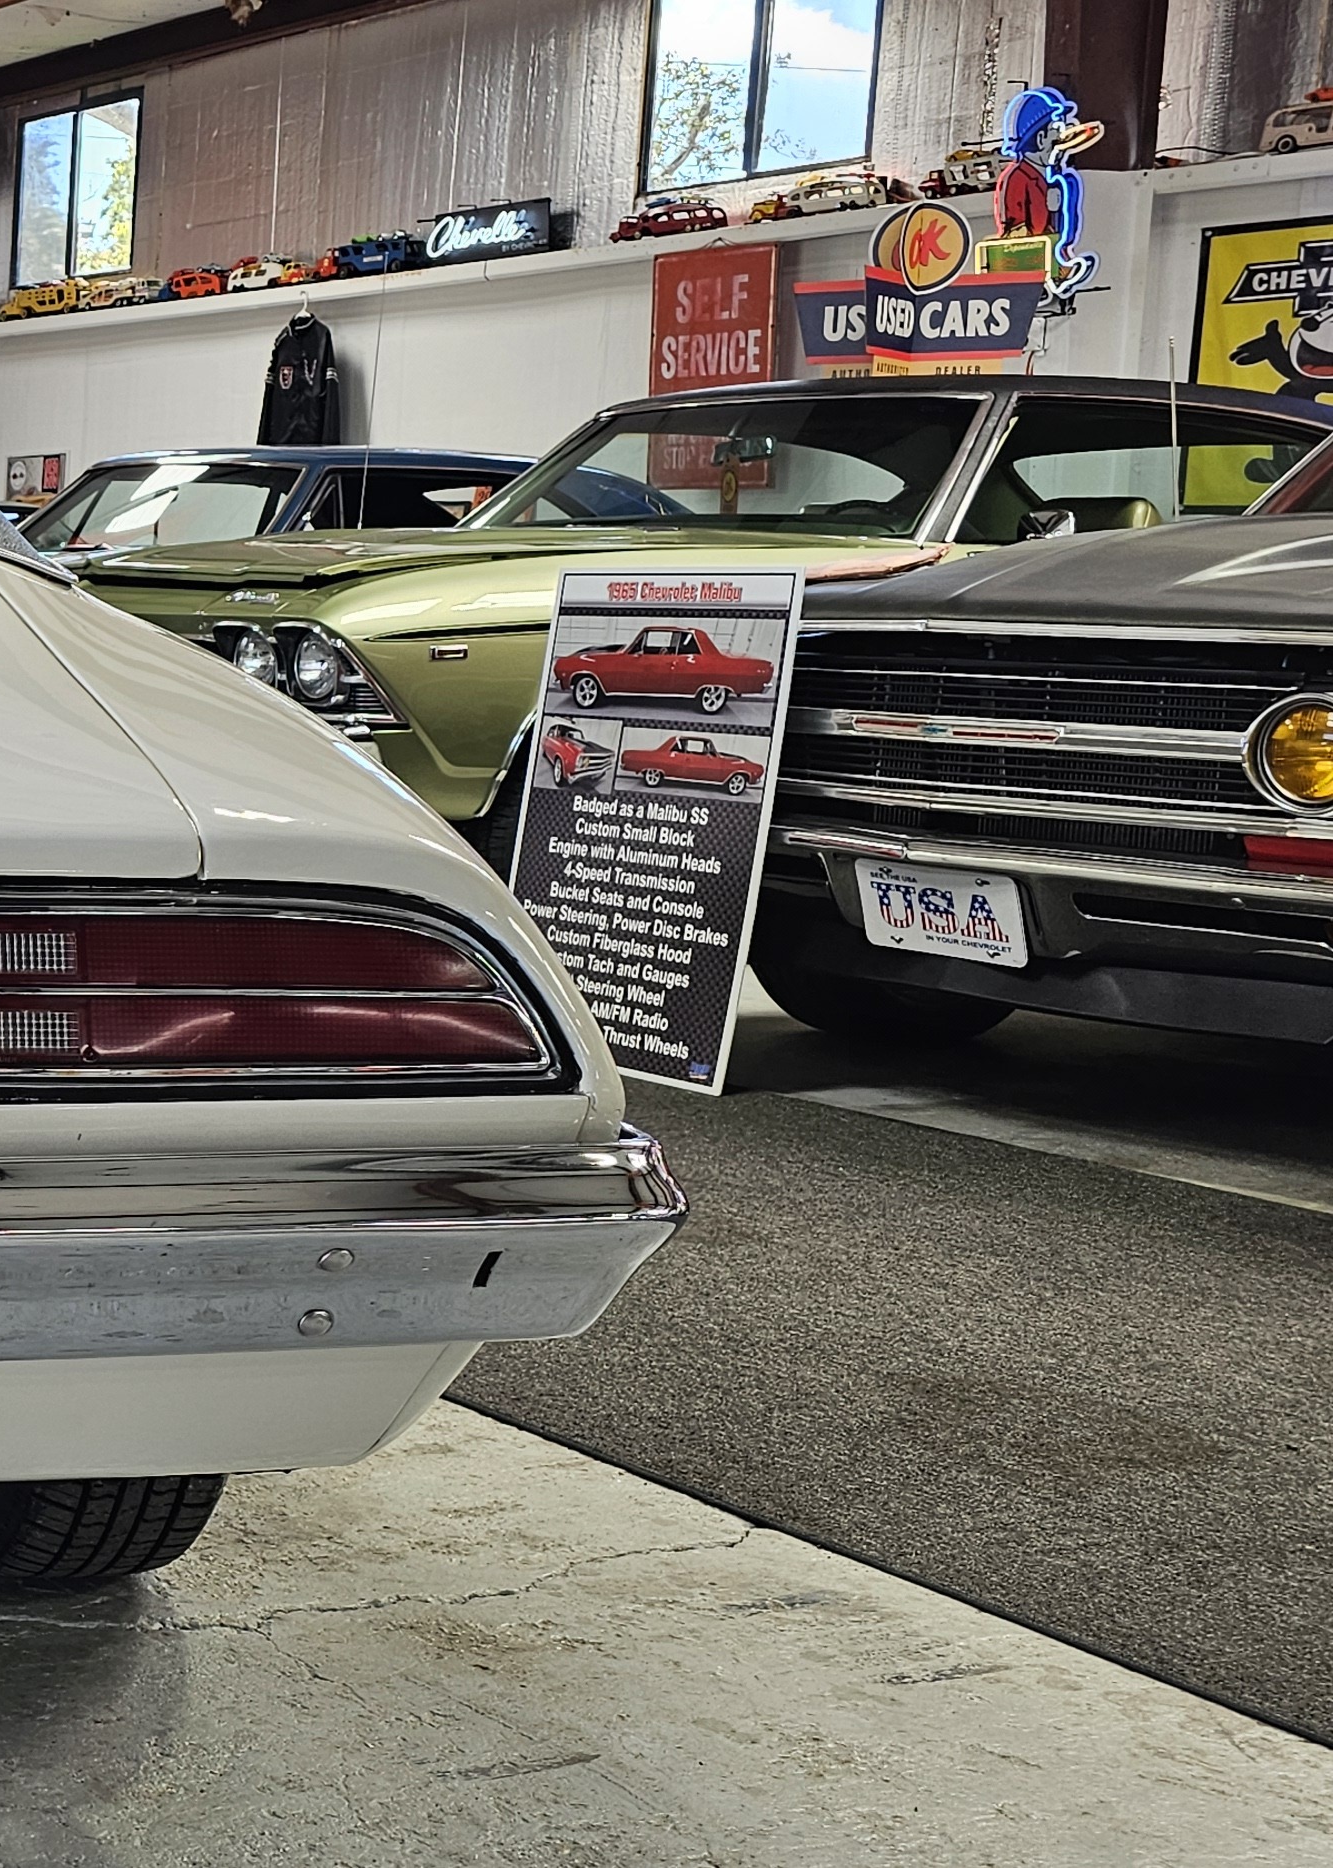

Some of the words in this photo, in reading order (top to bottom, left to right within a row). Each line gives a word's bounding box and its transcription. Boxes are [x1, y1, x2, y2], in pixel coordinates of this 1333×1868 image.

[425, 209, 527, 258] Chevelle
[909, 218, 951, 270] OK
[675, 273, 749, 325] SELF
[875, 295, 915, 338] USED
[919, 298, 1010, 339] CARS
[823, 305, 866, 342] US
[660, 327, 761, 379] SERVICE
[935, 365, 981, 376] DEALER
[606, 581, 638, 601] 1965
[640, 581, 697, 601] Chevrolet
[700, 582, 742, 602] Malibu
[573, 795, 618, 816] Badged
[619, 802, 634, 816] as
[636, 806, 644, 818] a
[647, 803, 688, 823] Malibu
[690, 807, 709, 825] SS
[575, 818, 620, 838] Custom
[623, 823, 657, 842] Small
[659, 827, 695, 847] Block
[549, 837, 588, 859] Engine
[590, 842, 614, 859] with
[616, 846, 678, 868] Aluminum
[681, 853, 722, 874] Heads
[564, 862, 611, 884] 4-Speed
[614, 867, 695, 894] Transmission
[550, 883, 589, 901] Bucket
[592, 889, 624, 907] Seats
[627, 894, 649, 911] and
[653, 897, 704, 919] Console
[871, 881, 1009, 943] USA
[523, 899, 558, 919] Power
[559, 905, 609, 931] Steering,
[612, 914, 651, 935] Power
[653, 919, 680, 940] Disc
[684, 923, 729, 947] Brakes
[547, 925, 590, 948] Custom
[592, 931, 655, 959] Fiberglass
[657, 942, 692, 965] Hood
[937, 936, 959, 945] YOUR
[962, 940, 1012, 953] CHEVROLET
[557, 951, 584, 970] stom
[587, 954, 614, 974] Tach
[617, 959, 639, 977] and
[642, 961, 690, 988] Gauges
[577, 975, 624, 1002] Steering
[627, 984, 665, 1007] Wheel
[590, 999, 631, 1024] AM/FM
[633, 1007, 669, 1031] Radio
[603, 1024, 642, 1049] Thrust
[644, 1034, 689, 1060] Wheels
